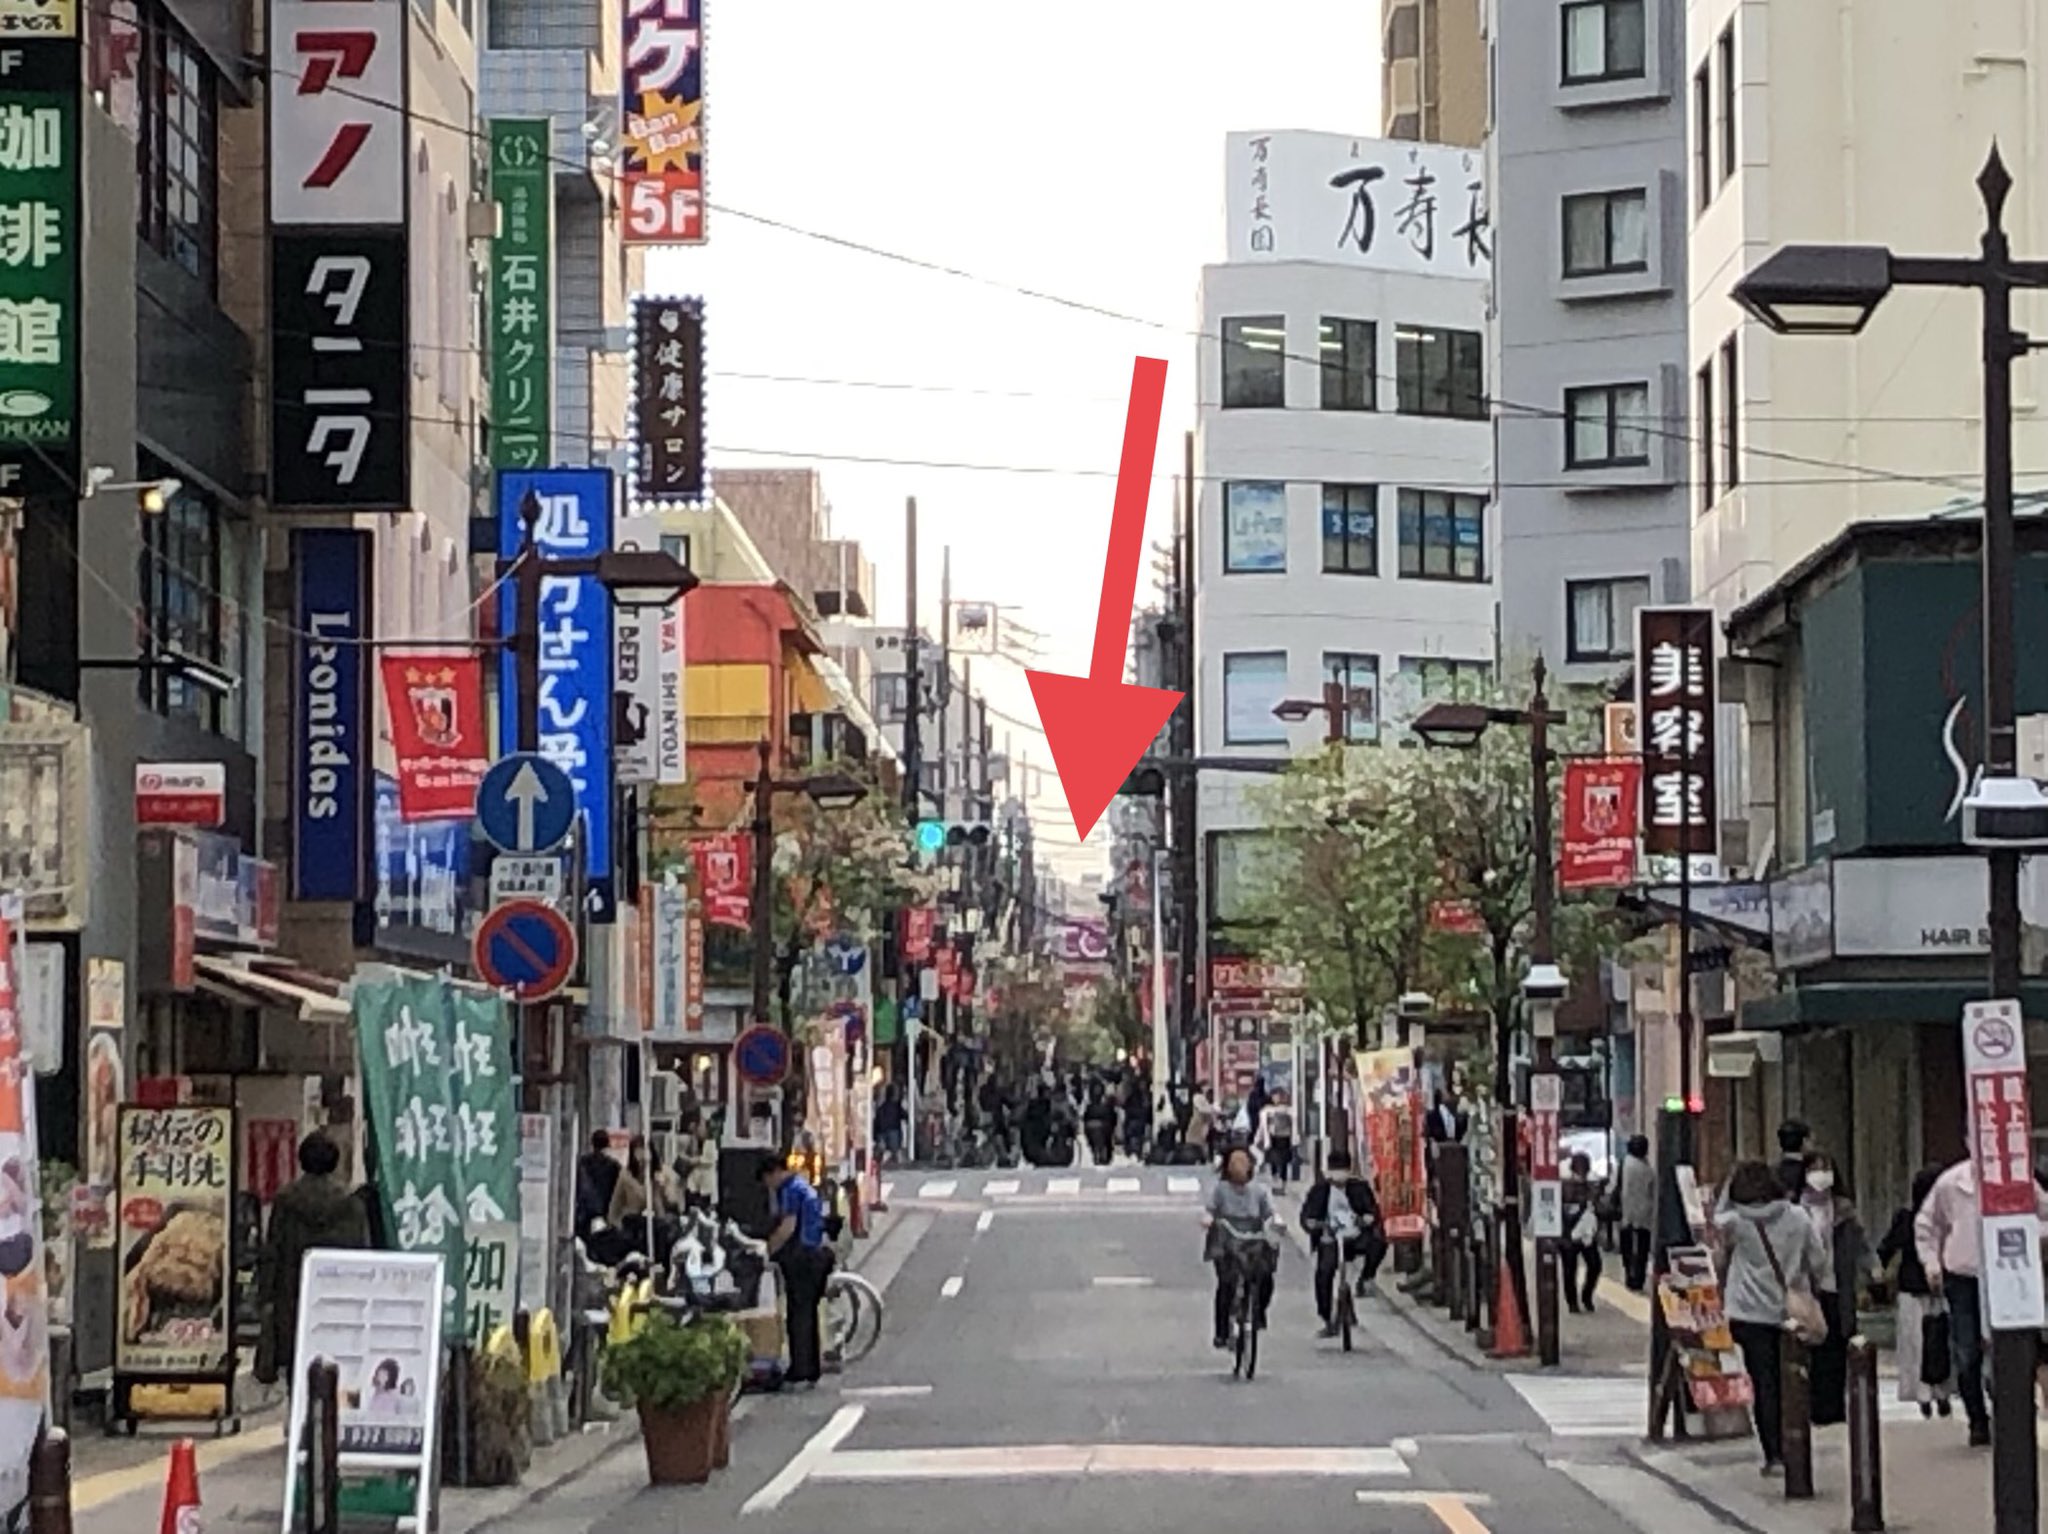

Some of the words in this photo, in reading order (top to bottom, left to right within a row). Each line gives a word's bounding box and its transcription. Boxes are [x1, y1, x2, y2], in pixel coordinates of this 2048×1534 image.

[628, 0, 698, 93] ケ
[628, 112, 678, 140] Ban
[648, 126, 699, 155] Ban
[630, 180, 700, 235] 5F
[304, 255, 372, 485] タニタ
[1650, 641, 1707, 826] 美容室
[1920, 927, 1971, 946] HAIR
[127, 1150, 227, 1189] 手羽先
